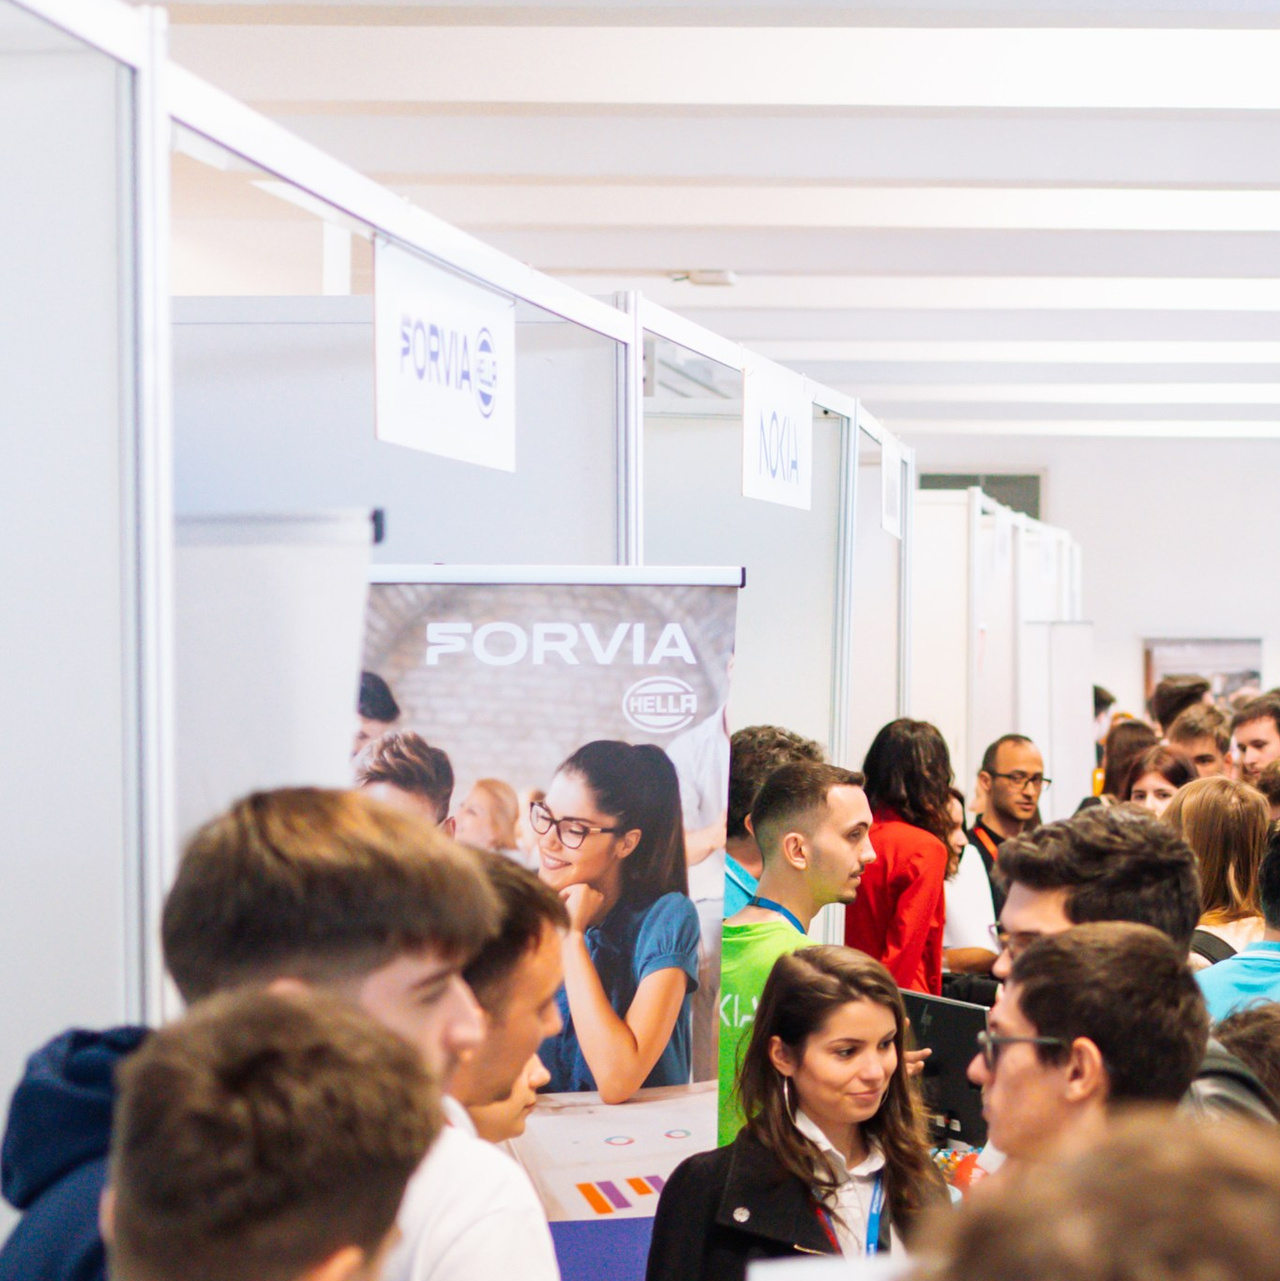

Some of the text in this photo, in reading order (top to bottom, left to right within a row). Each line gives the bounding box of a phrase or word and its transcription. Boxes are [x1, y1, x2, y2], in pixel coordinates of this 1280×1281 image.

[400, 313, 473, 394] FORVIA
[759, 408, 799, 485] NOKIA
[426, 622, 697, 665] FORVIA
[629, 694, 697, 713] HELLA
